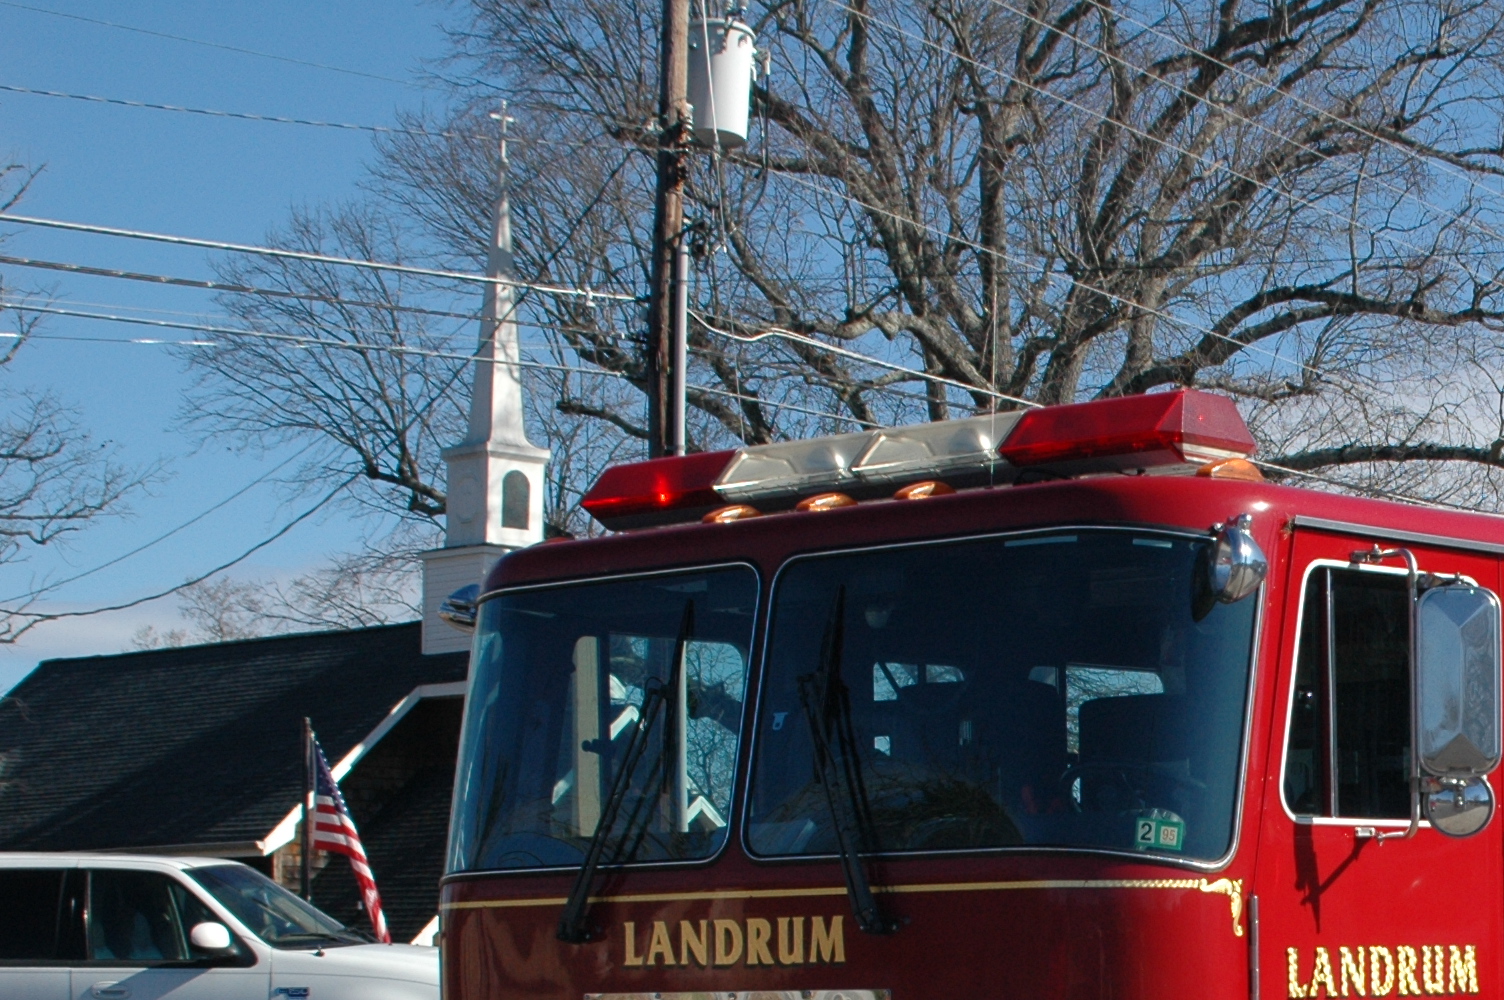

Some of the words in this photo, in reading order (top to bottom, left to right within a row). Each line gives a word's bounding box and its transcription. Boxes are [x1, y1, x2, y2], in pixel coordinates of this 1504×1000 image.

[1140, 822, 1152, 841] 2
[1162, 828, 1176, 842] 95
[623, 915, 846, 967] LANDRUM
[1286, 945, 1480, 1000] LANDRUM
